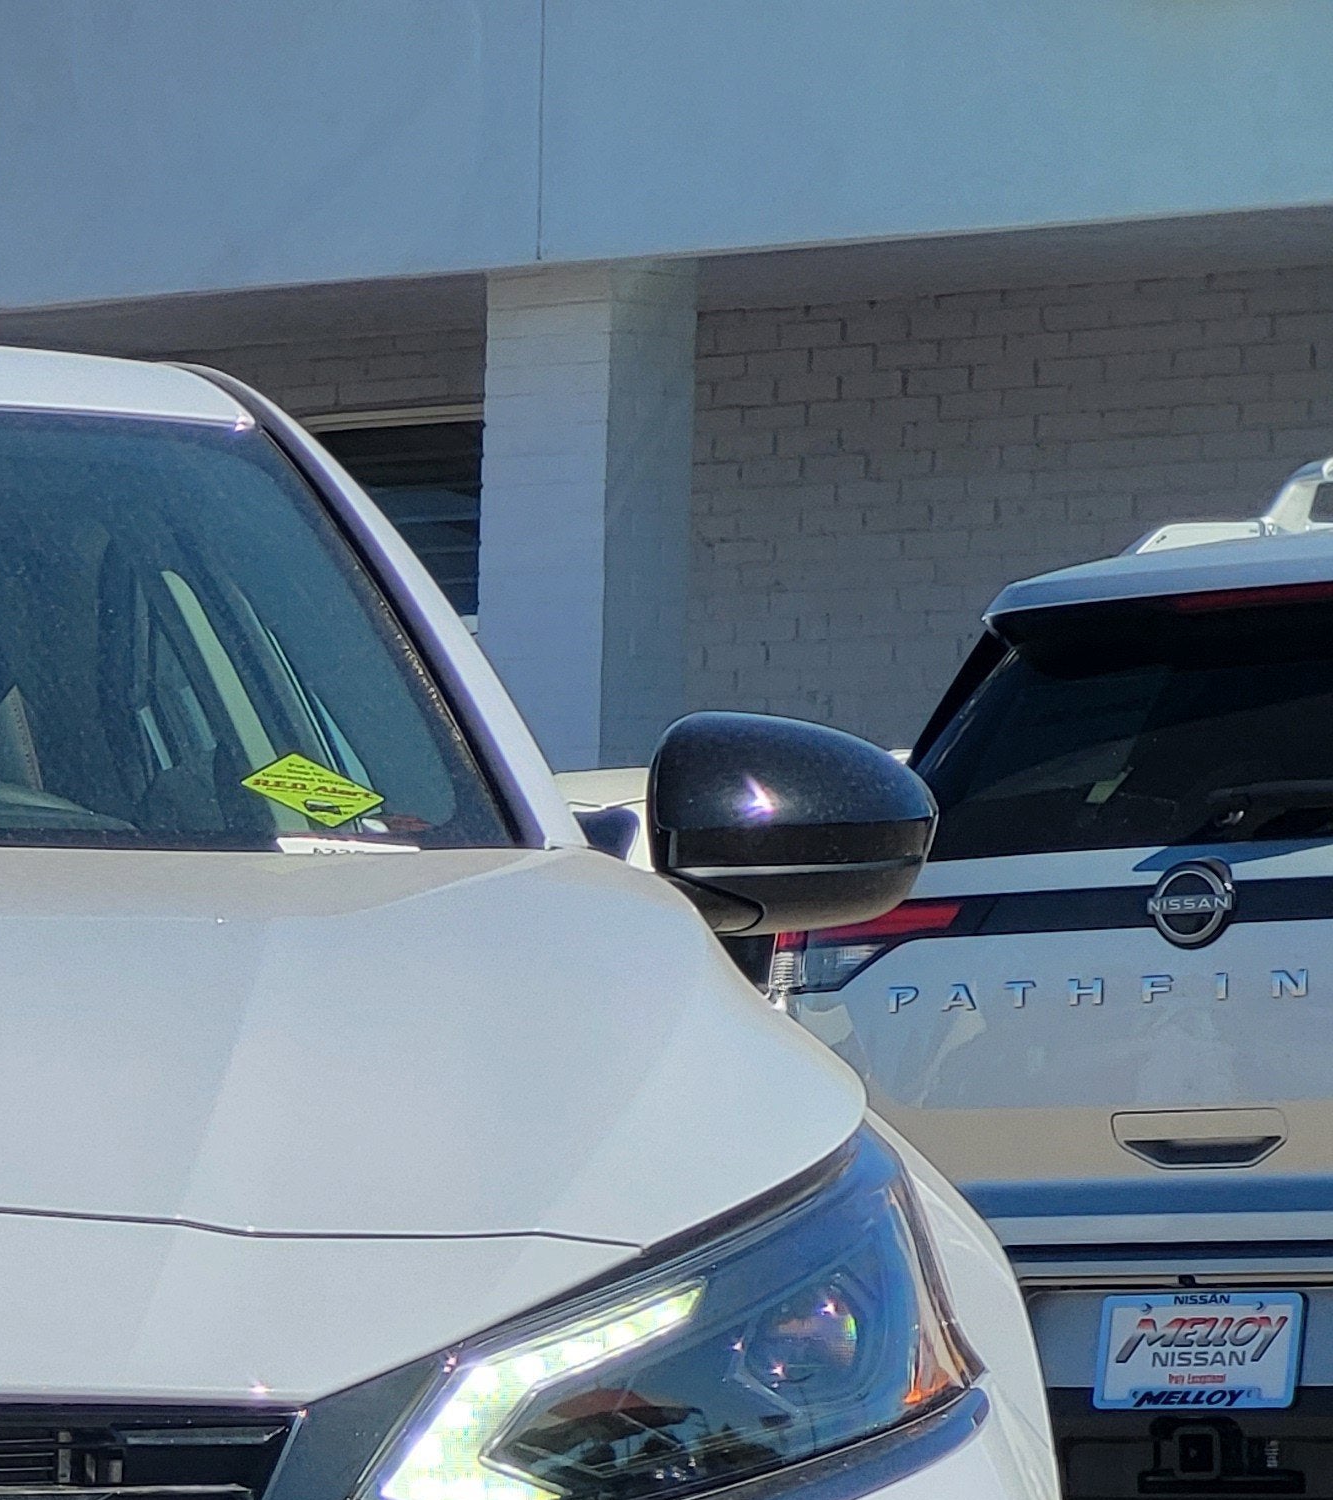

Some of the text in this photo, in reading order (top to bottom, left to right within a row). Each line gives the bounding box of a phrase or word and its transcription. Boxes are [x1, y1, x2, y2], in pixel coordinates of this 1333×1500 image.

[1148, 896, 1228, 913] NISSAN
[888, 968, 1309, 1014] PATHFIN
[1174, 1294, 1231, 1305] NISSAN
[1115, 1316, 1289, 1364] MELLOY
[1151, 1350, 1246, 1368] NISSAN
[1134, 1389, 1245, 1407] MELLOY
